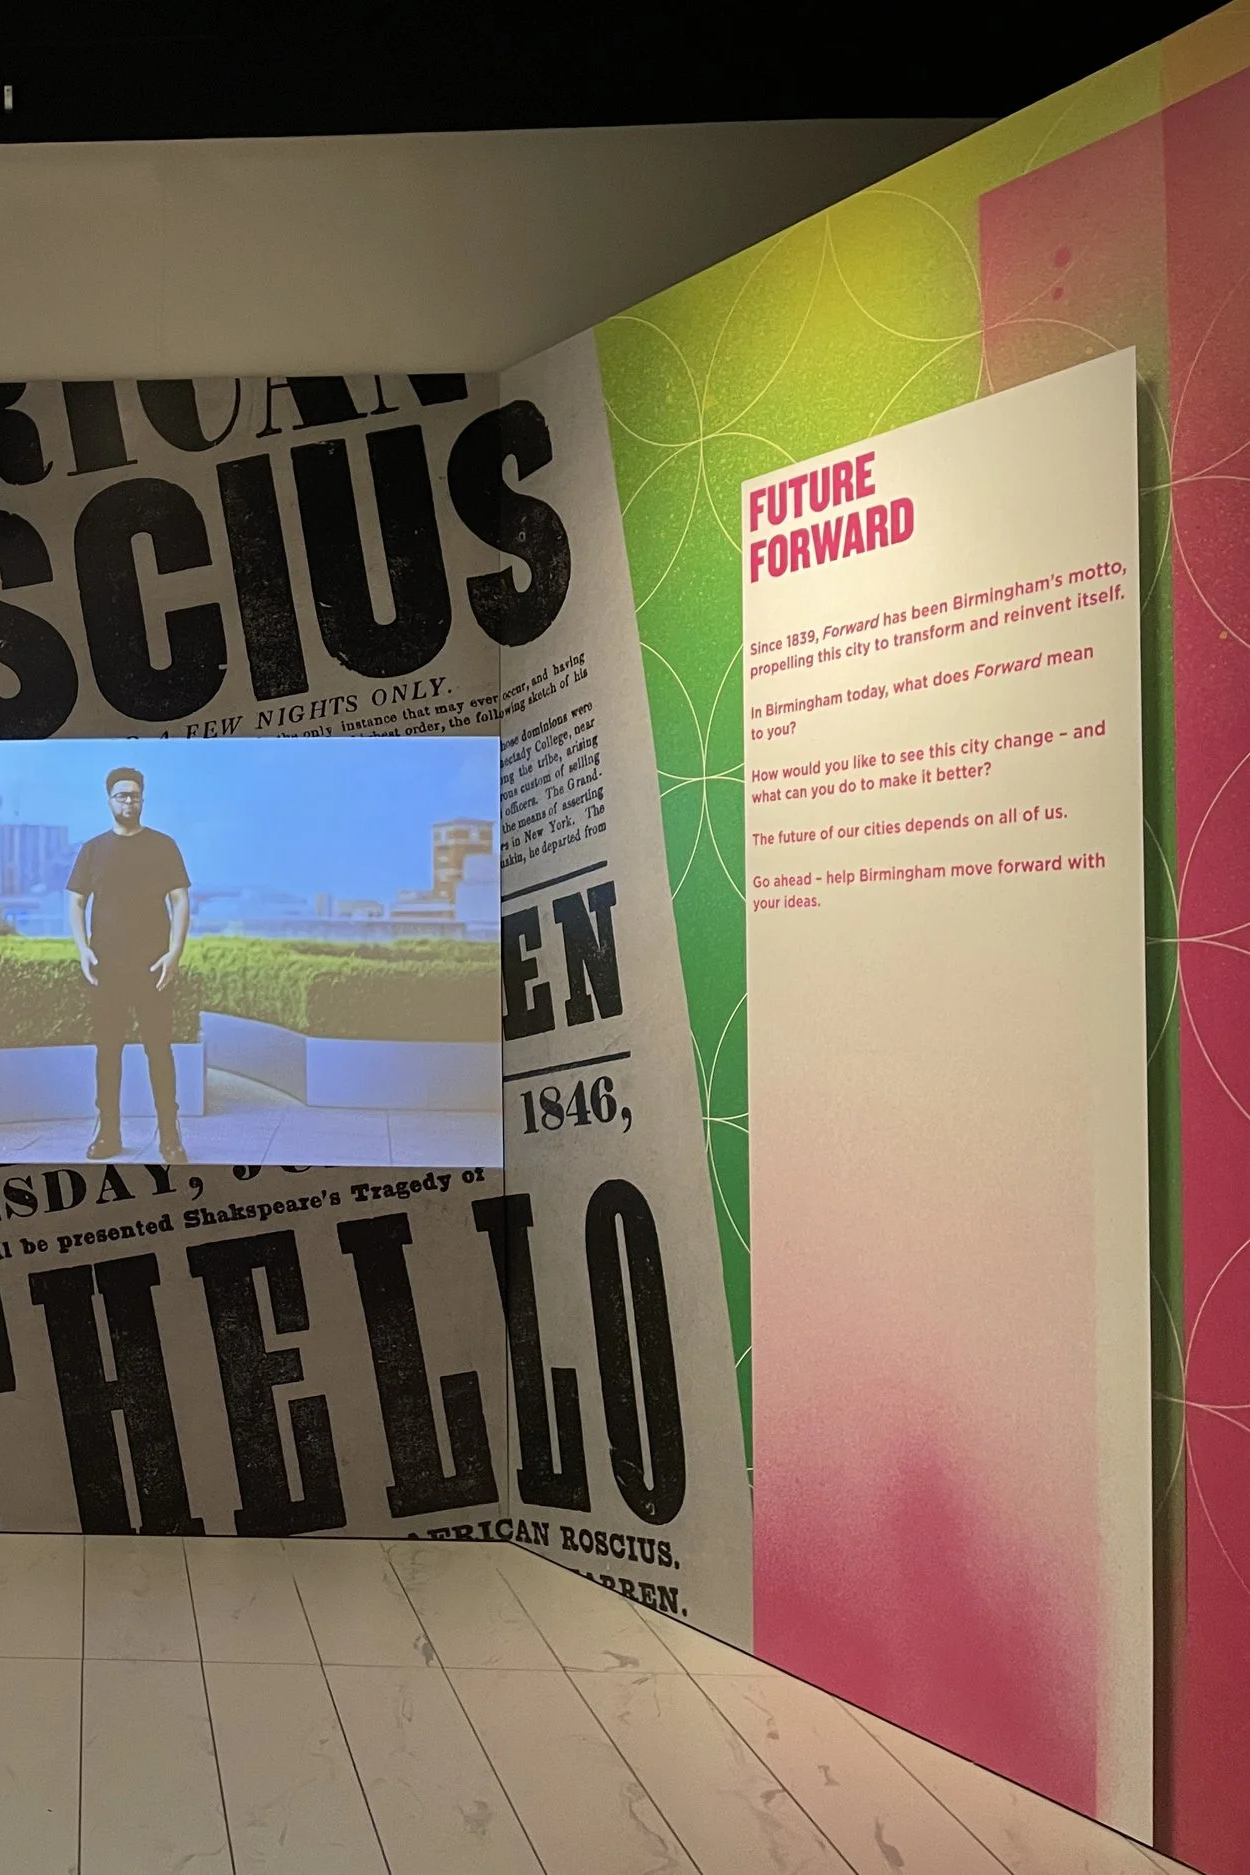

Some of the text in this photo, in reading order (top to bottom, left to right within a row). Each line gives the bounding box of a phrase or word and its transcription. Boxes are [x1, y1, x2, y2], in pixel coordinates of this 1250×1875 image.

[750, 450, 875, 533] FUTURE
[750, 497, 914, 584] FORWARD
[750, 562, 1126, 655] Since 1839, Forward has been Birmingham's motto,
[751, 584, 1124, 680] propelling this city to transform and reinvent itself.
[186, 677, 452, 739] FEW NIGHTS ONLY.
[341, 652, 586, 732] instance that may ever occur, and having
[405, 721, 446, 736] order,
[449, 716, 471, 729] the
[476, 701, 526, 723] following
[528, 683, 557, 705] sketch
[559, 674, 570, 690] of
[573, 667, 589, 683] his
[752, 647, 1093, 719] In Birmingham today, what does Forward mean
[521, 701, 593, 742] dominions were
[535, 718, 595, 752] College, near
[751, 721, 796, 740] to you?
[752, 770, 778, 782] How
[783, 760, 820, 778] would
[825, 760, 848, 775] you
[854, 754, 876, 769] like
[882, 752, 895, 765] to
[900, 750, 924, 762] see
[929, 742, 955, 758] this
[961, 739, 988, 754] city
[995, 732, 1053, 750] change
[1074, 720, 1105, 739] and
[752, 762, 991, 803] what can you do to make it better?
[524, 801, 606, 844] New York. The
[529, 820, 607, 858] he departed from
[752, 806, 1067, 845] The future of our cities depends on all of us.
[753, 876, 770, 888] Go
[774, 872, 811, 887] ahead
[827, 870, 854, 885] help
[860, 865, 945, 882] Birmingham
[951, 864, 992, 876] move
[998, 856, 1062, 874] forward
[1068, 852, 1105, 869] with
[754, 895, 820, 912] your ideas.
[520, 1075, 632, 1135] 1846,
[20, 1237, 48, 1256] be
[57, 1214, 175, 1254] presented
[184, 1189, 341, 1229] Shakspeare's
[350, 1169, 451, 1202] Tragedy
[461, 1167, 486, 1183] of
[560, 1525, 680, 1570] ROSCIUS.
[570, 1569, 688, 1617] RREN.
